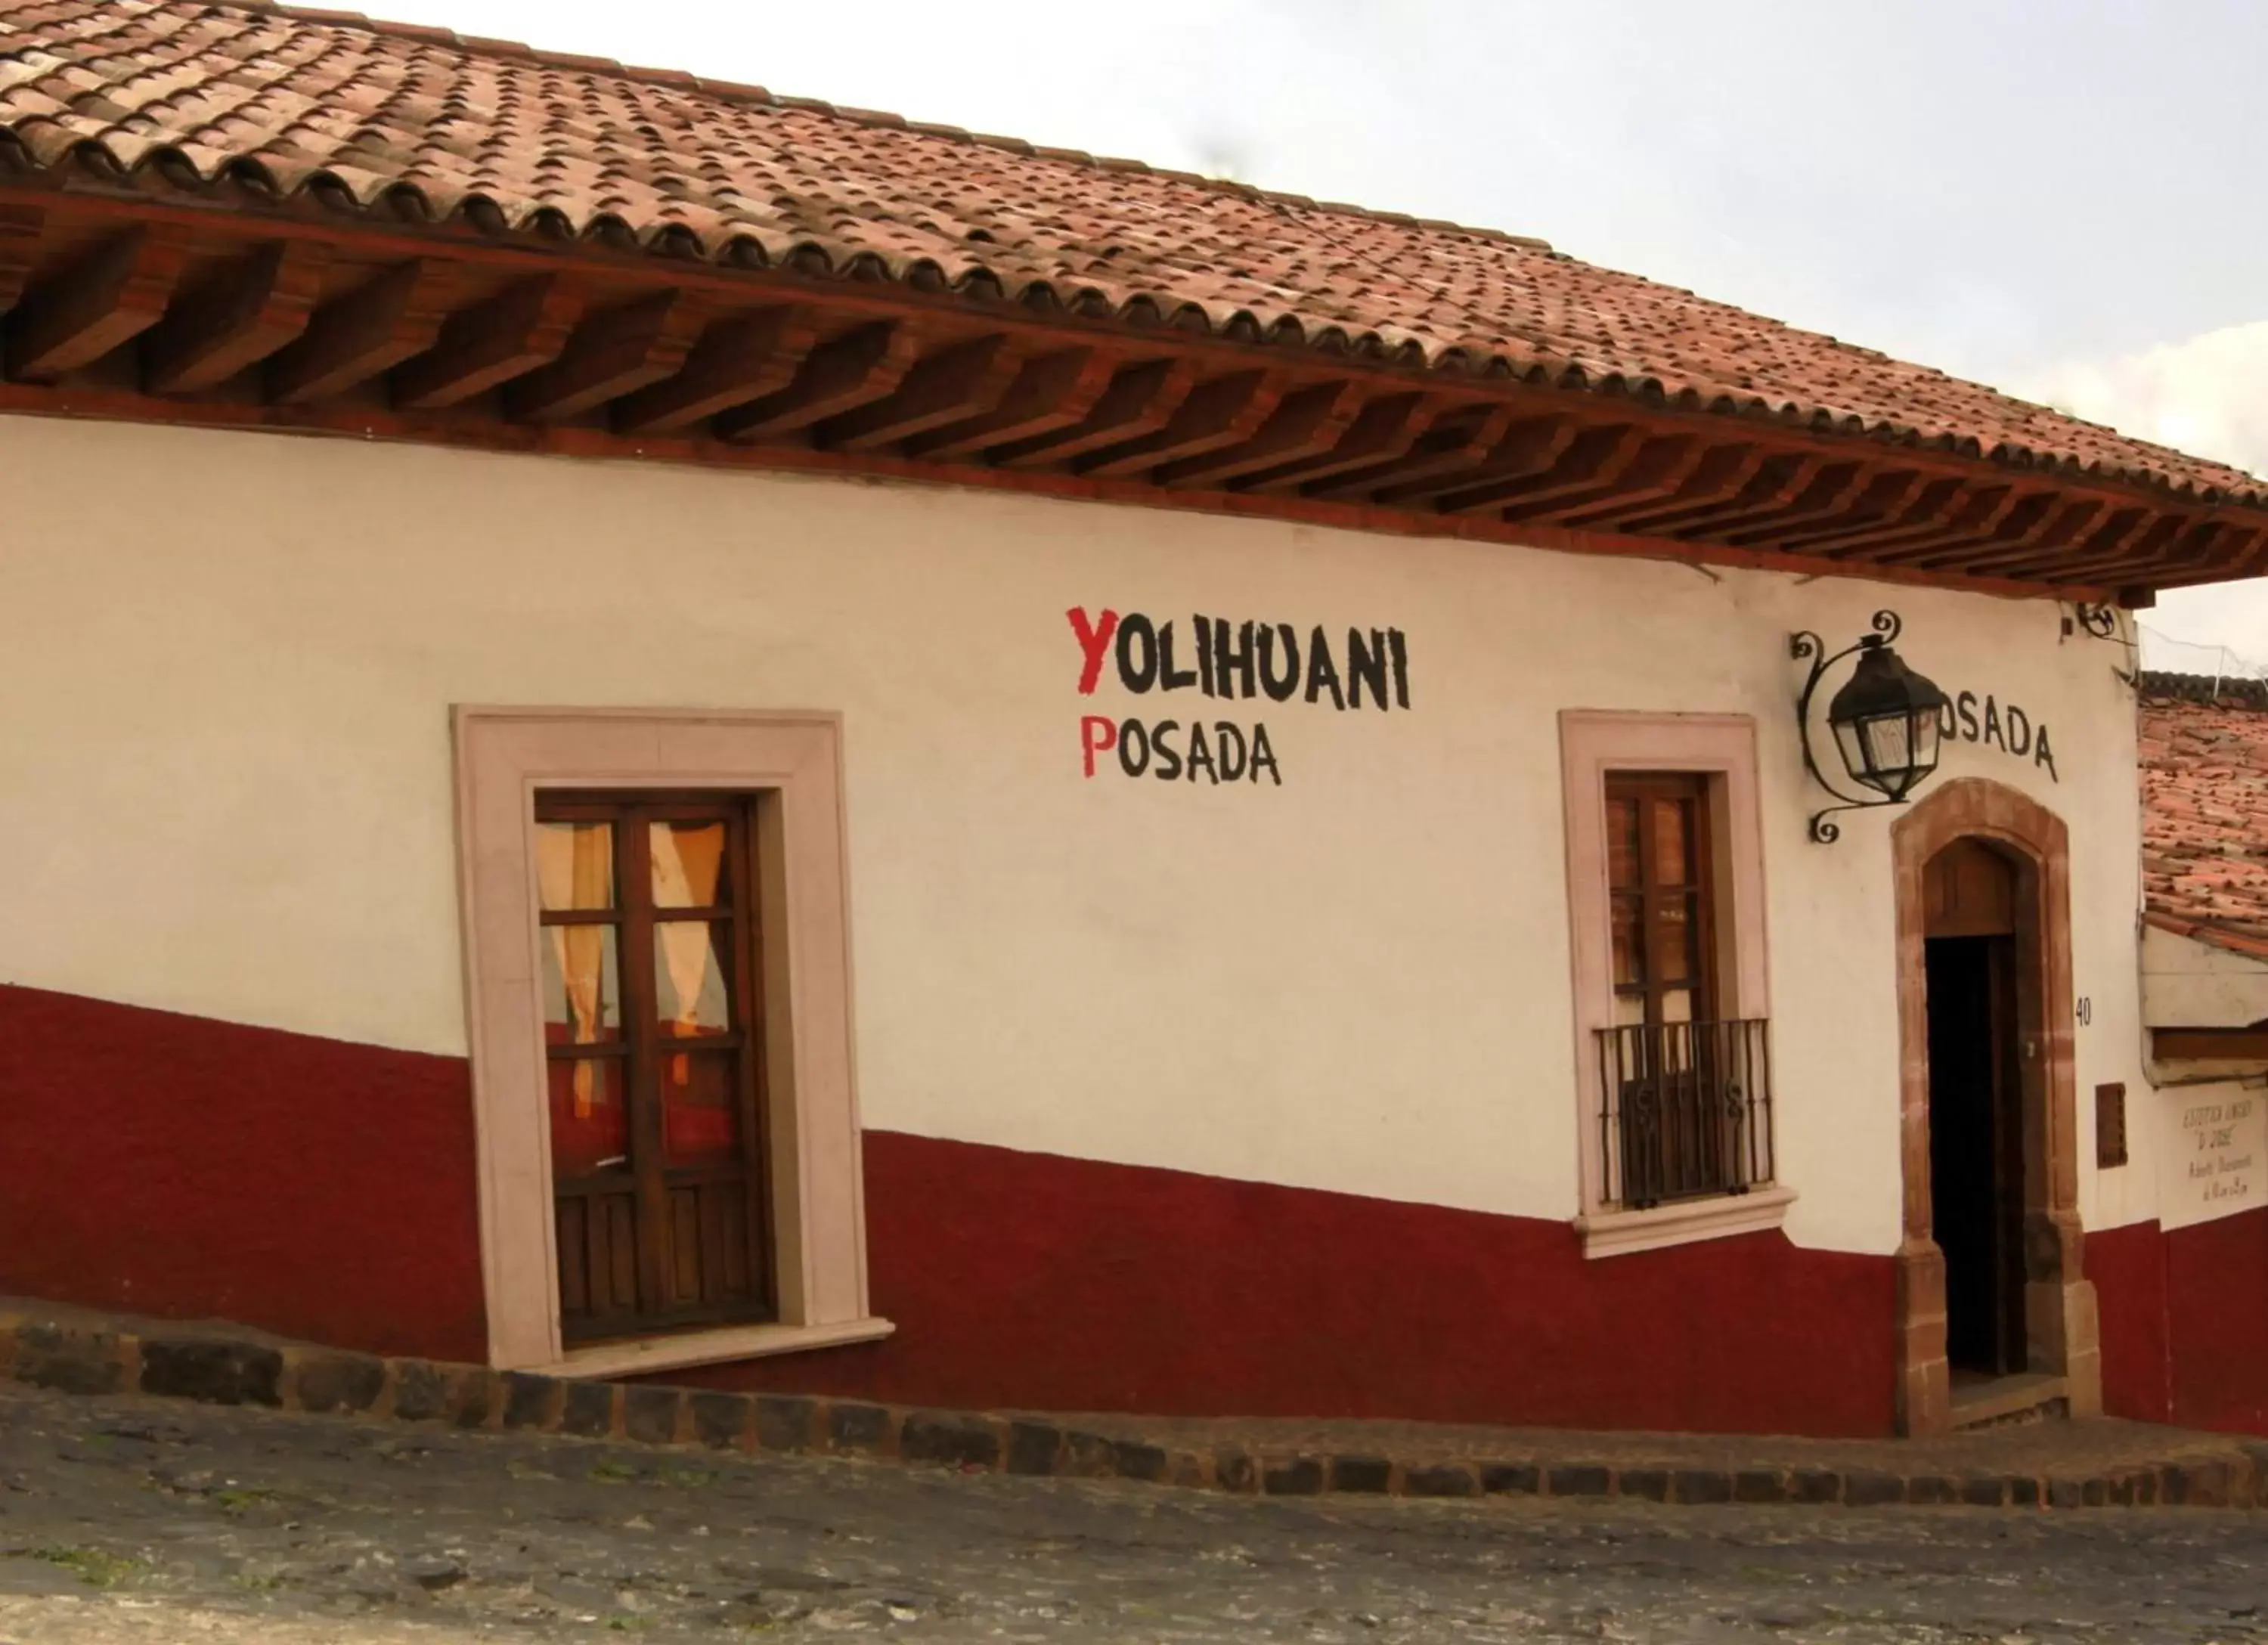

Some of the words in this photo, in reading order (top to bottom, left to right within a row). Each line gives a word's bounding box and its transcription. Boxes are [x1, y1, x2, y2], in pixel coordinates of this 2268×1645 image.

[1066, 606, 1410, 711] YOLIHUANI
[1081, 715, 1282, 786] POSADA
[2075, 996, 2091, 1027] 40
